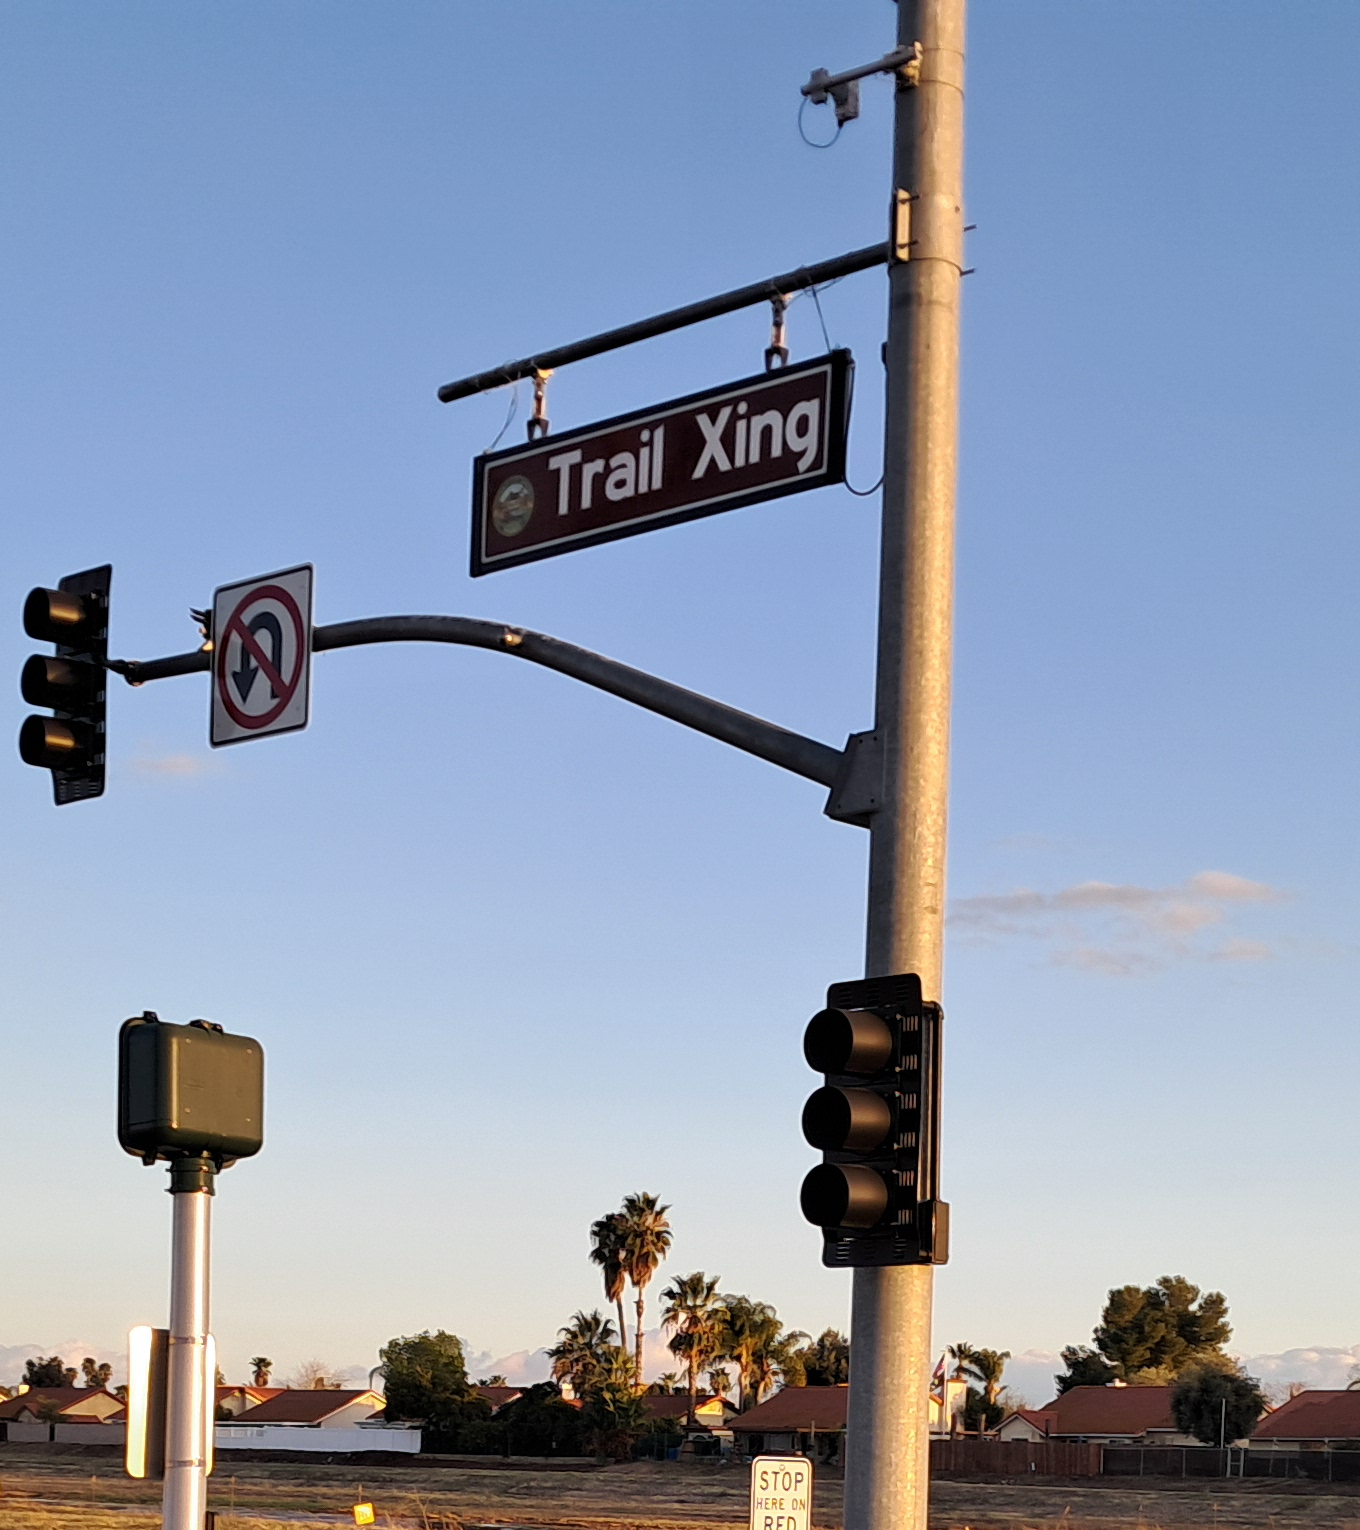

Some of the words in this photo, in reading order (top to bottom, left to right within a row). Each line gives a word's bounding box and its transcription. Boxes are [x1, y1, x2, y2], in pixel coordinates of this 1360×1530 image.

[548, 424, 665, 516] Trail
[691, 398, 820, 480] Xing
[760, 1471, 804, 1491] STOP
[756, 1497, 785, 1510] HERE
[791, 1498, 806, 1511] ON
